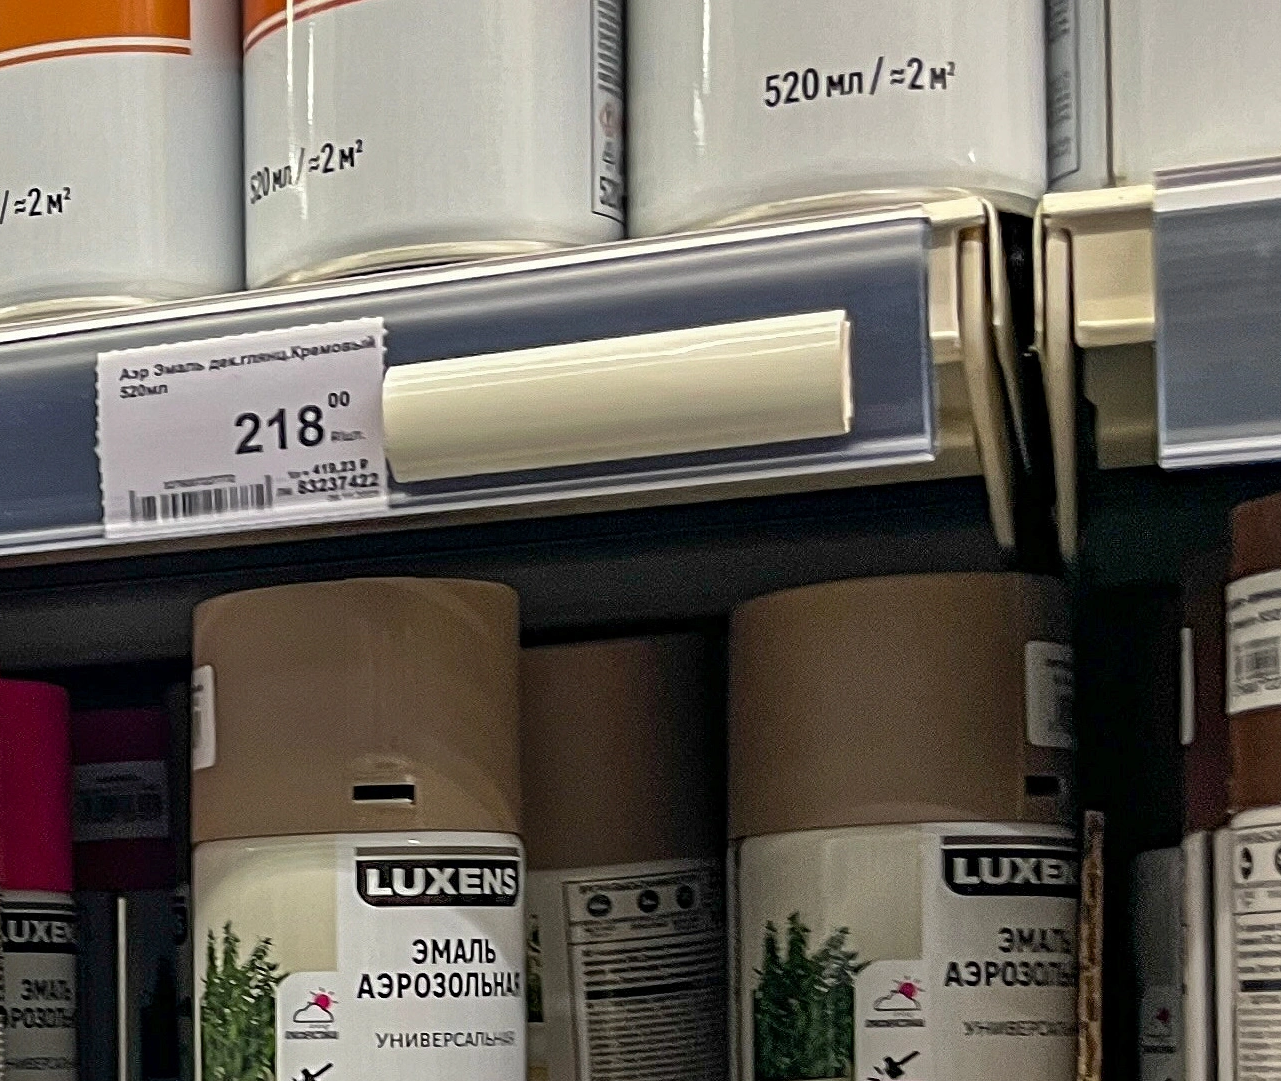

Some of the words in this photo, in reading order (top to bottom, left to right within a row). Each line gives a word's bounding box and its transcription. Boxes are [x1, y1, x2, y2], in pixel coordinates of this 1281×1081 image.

[234, 404, 325, 455] 218
[327, 391, 350, 408] 00
[366, 867, 518, 897] LUXENS
[411, 938, 496, 965] ЭМАЛЬ
